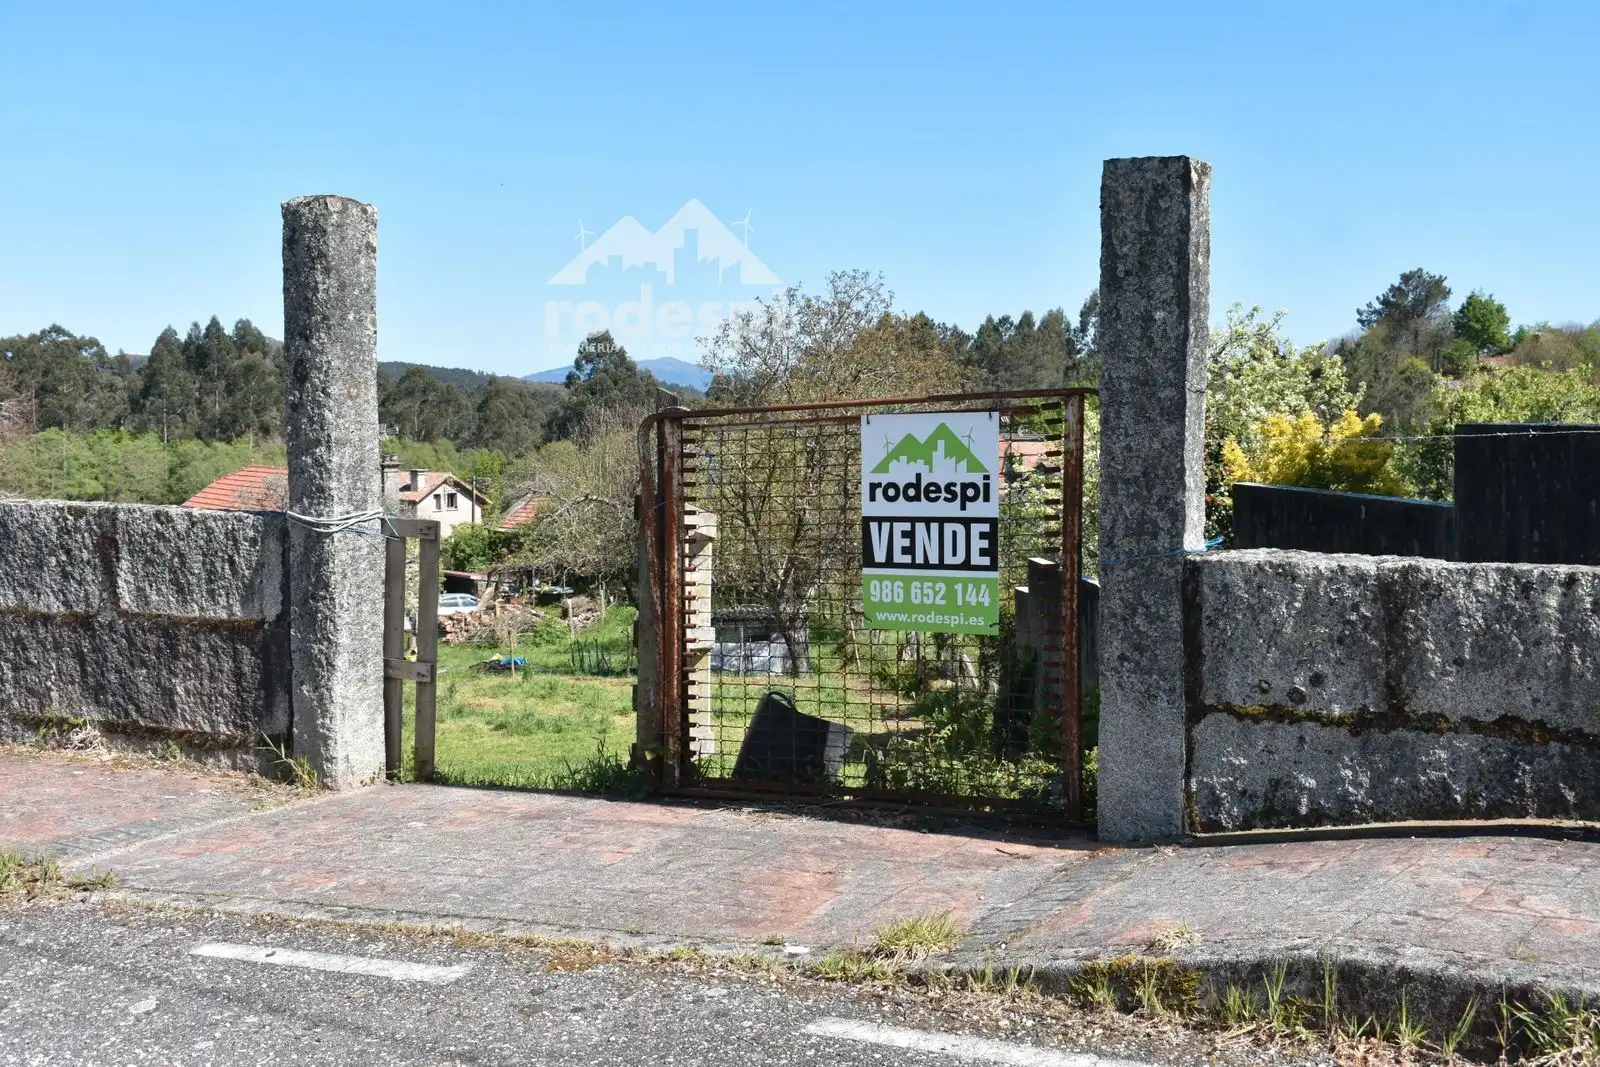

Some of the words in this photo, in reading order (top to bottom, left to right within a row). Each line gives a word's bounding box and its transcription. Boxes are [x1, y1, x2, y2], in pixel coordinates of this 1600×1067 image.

[869, 473, 991, 511] rodespi
[869, 521, 991, 566] VENDE
[870, 580, 904, 603] 986
[911, 581, 946, 605] 652
[954, 582, 991, 607] 144
[875, 610, 985, 628] www.rodespi.es
